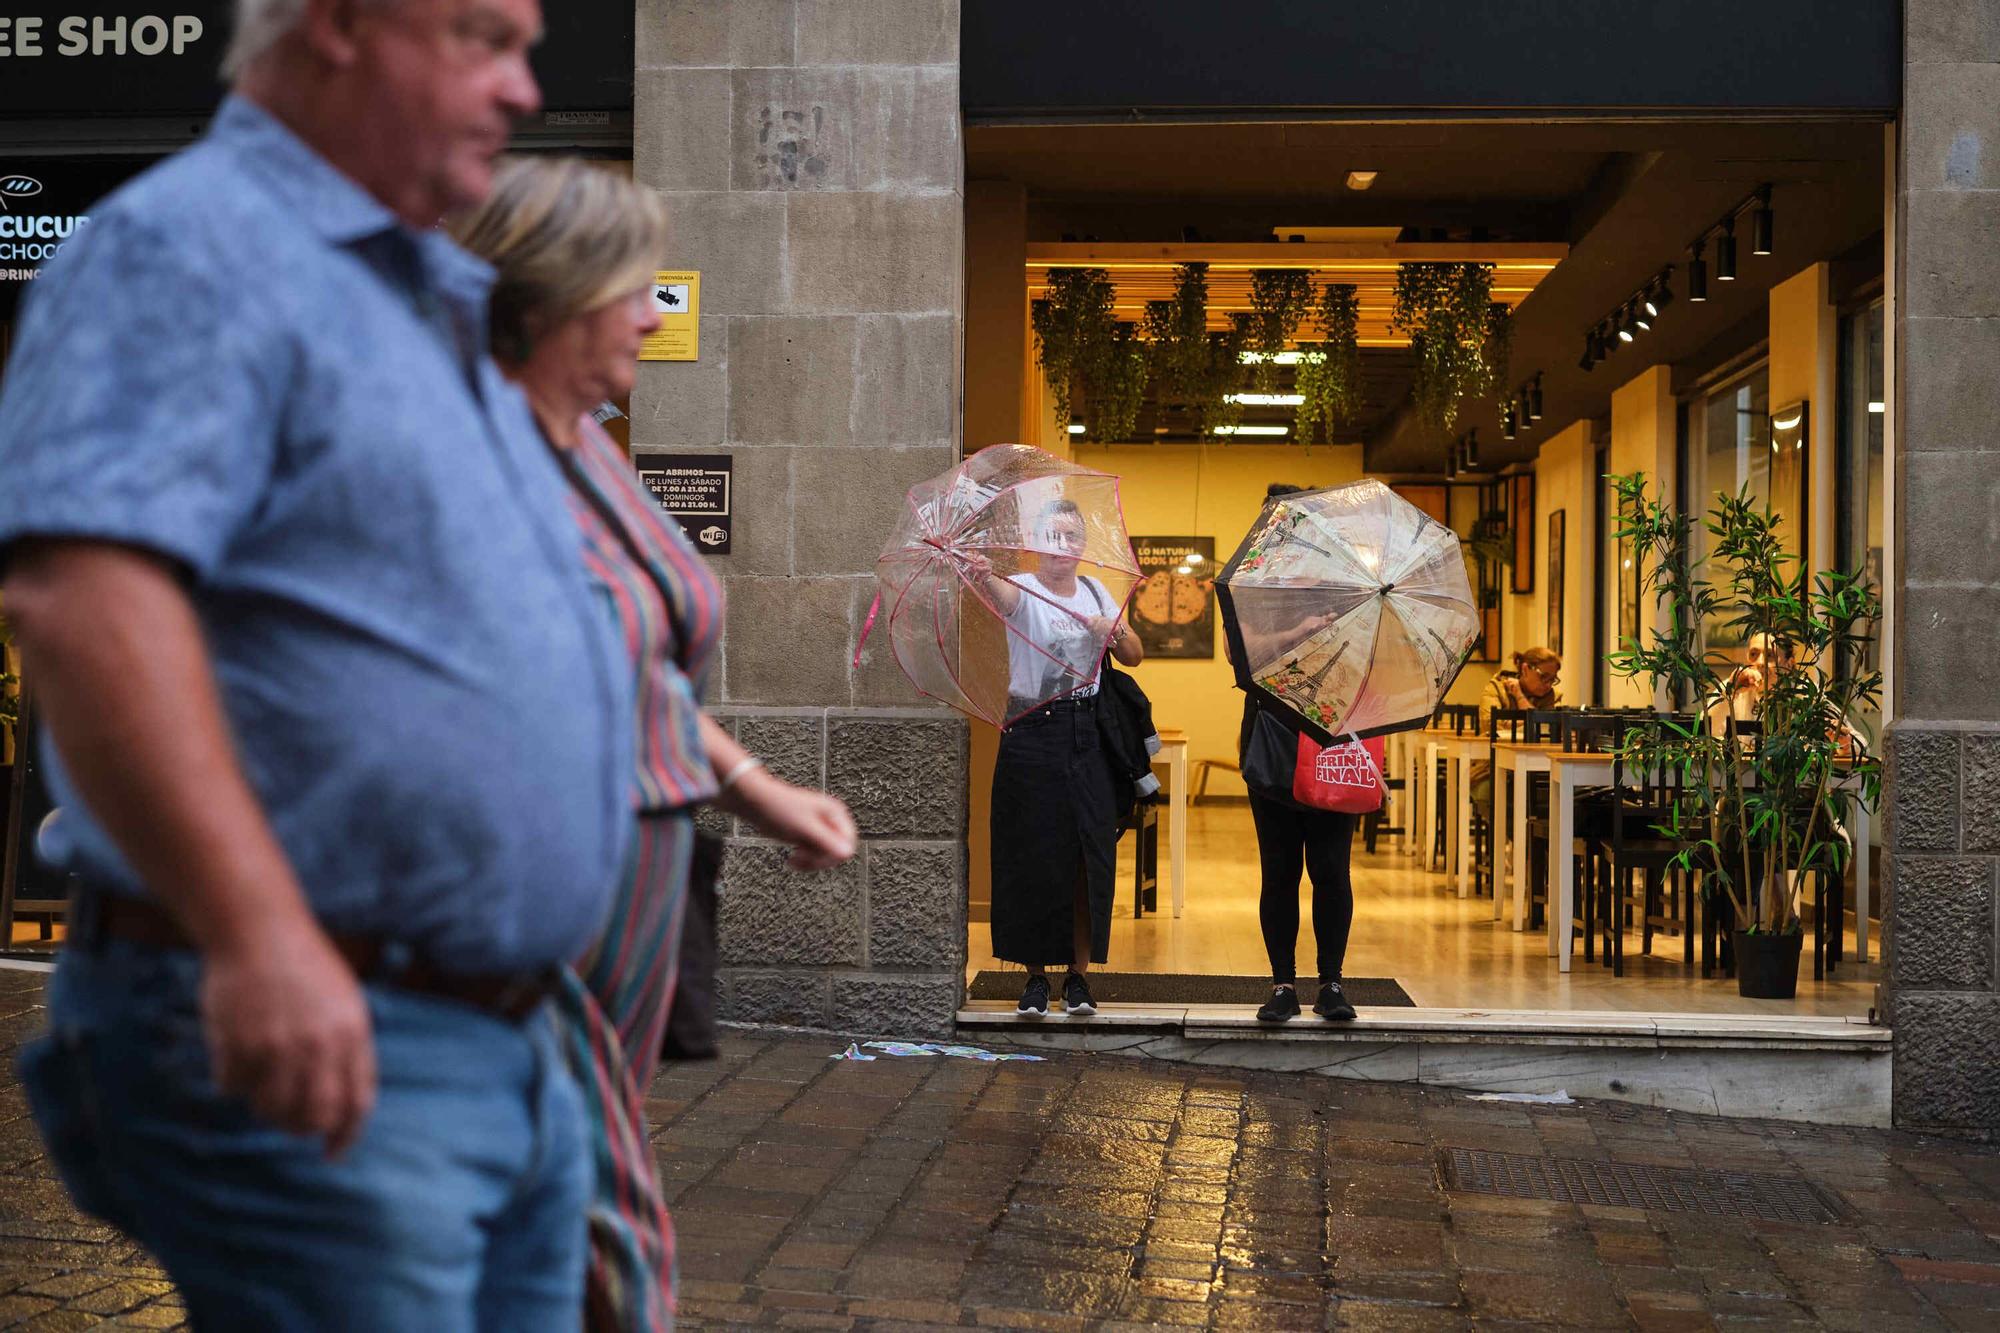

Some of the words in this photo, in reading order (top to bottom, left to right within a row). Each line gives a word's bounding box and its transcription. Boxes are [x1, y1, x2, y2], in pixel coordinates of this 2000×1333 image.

[58, 15, 204, 57] SHOP
[1138, 547, 1151, 556] LO
[1139, 556, 1167, 565] 100%
[1316, 766, 1376, 788] FINAL
